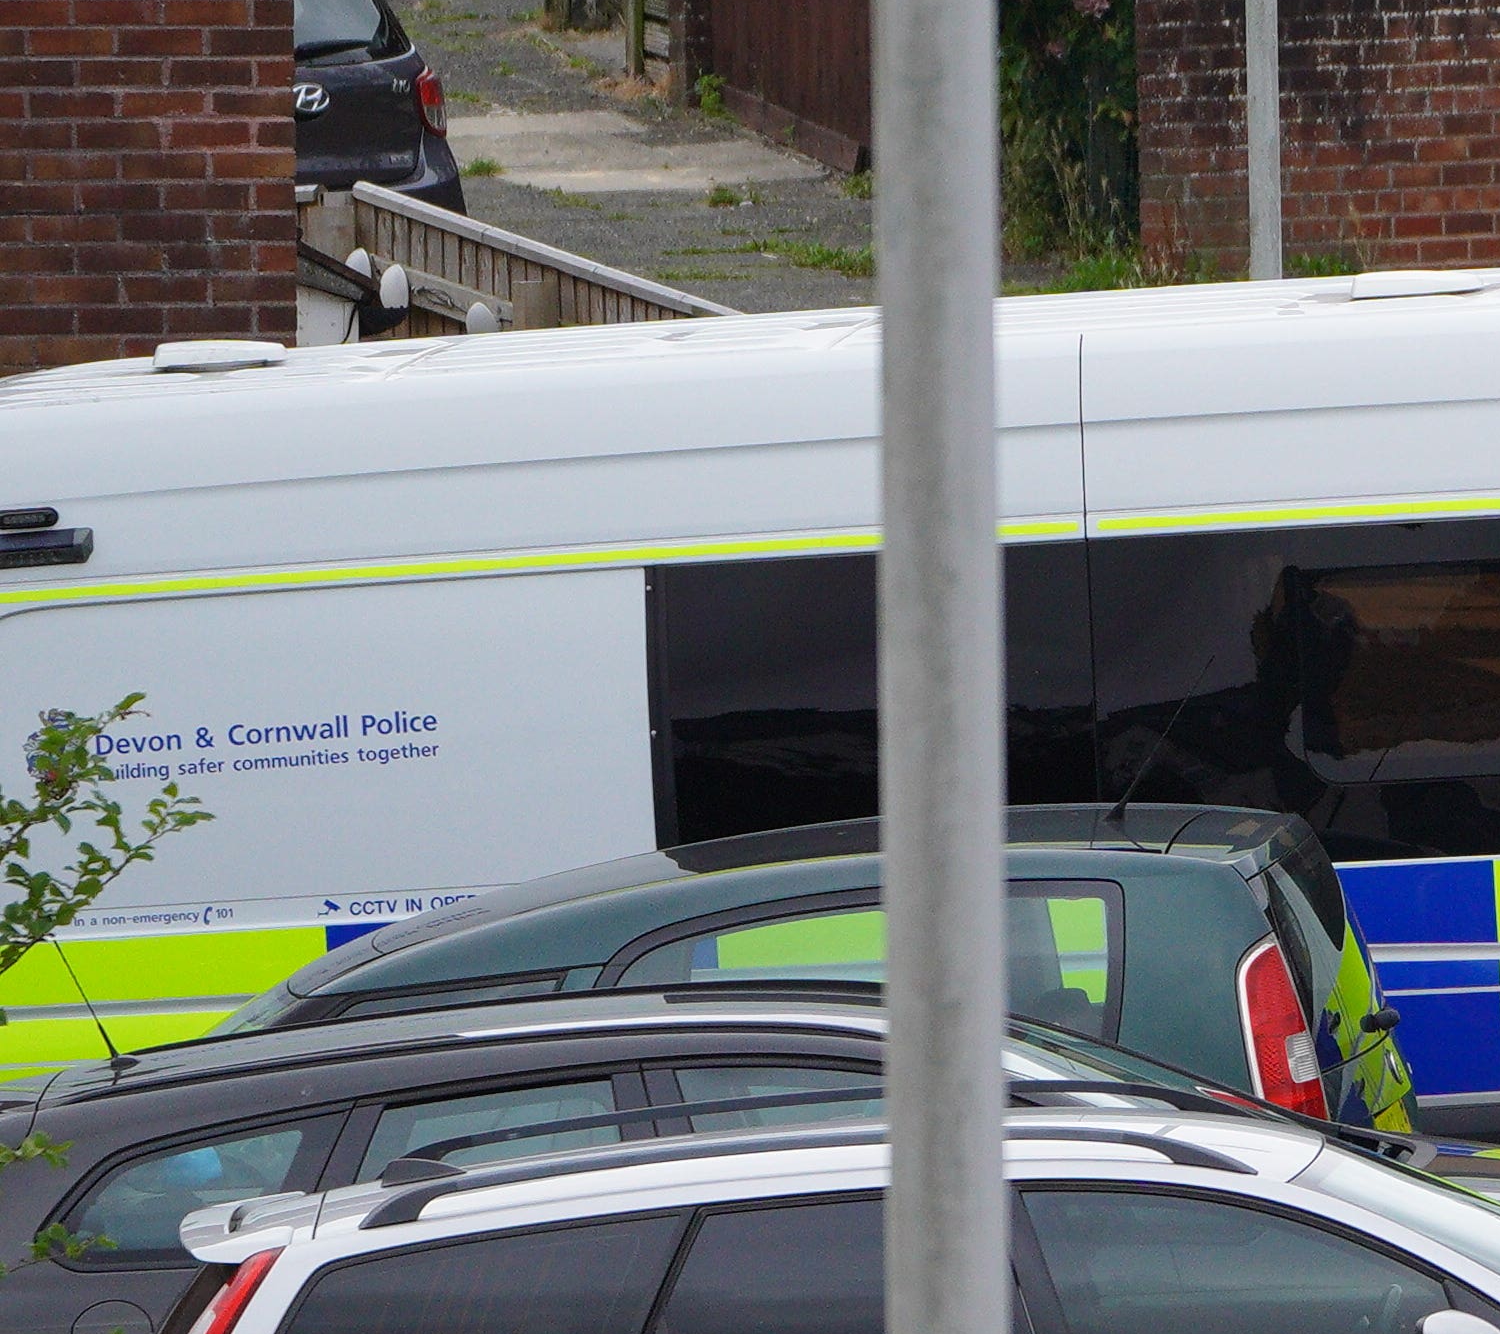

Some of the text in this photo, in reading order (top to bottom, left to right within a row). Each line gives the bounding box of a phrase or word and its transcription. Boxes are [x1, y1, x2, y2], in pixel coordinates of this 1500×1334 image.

[95, 711, 438, 756] Devon & Cornwall Police
[98, 742, 439, 781] uilding safer communities together
[216, 908, 233, 919] 101
[350, 899, 397, 916] CCTV
[406, 898, 422, 912] IN
[91, 918, 97, 926] a
[103, 909, 199, 926] non-emergency
